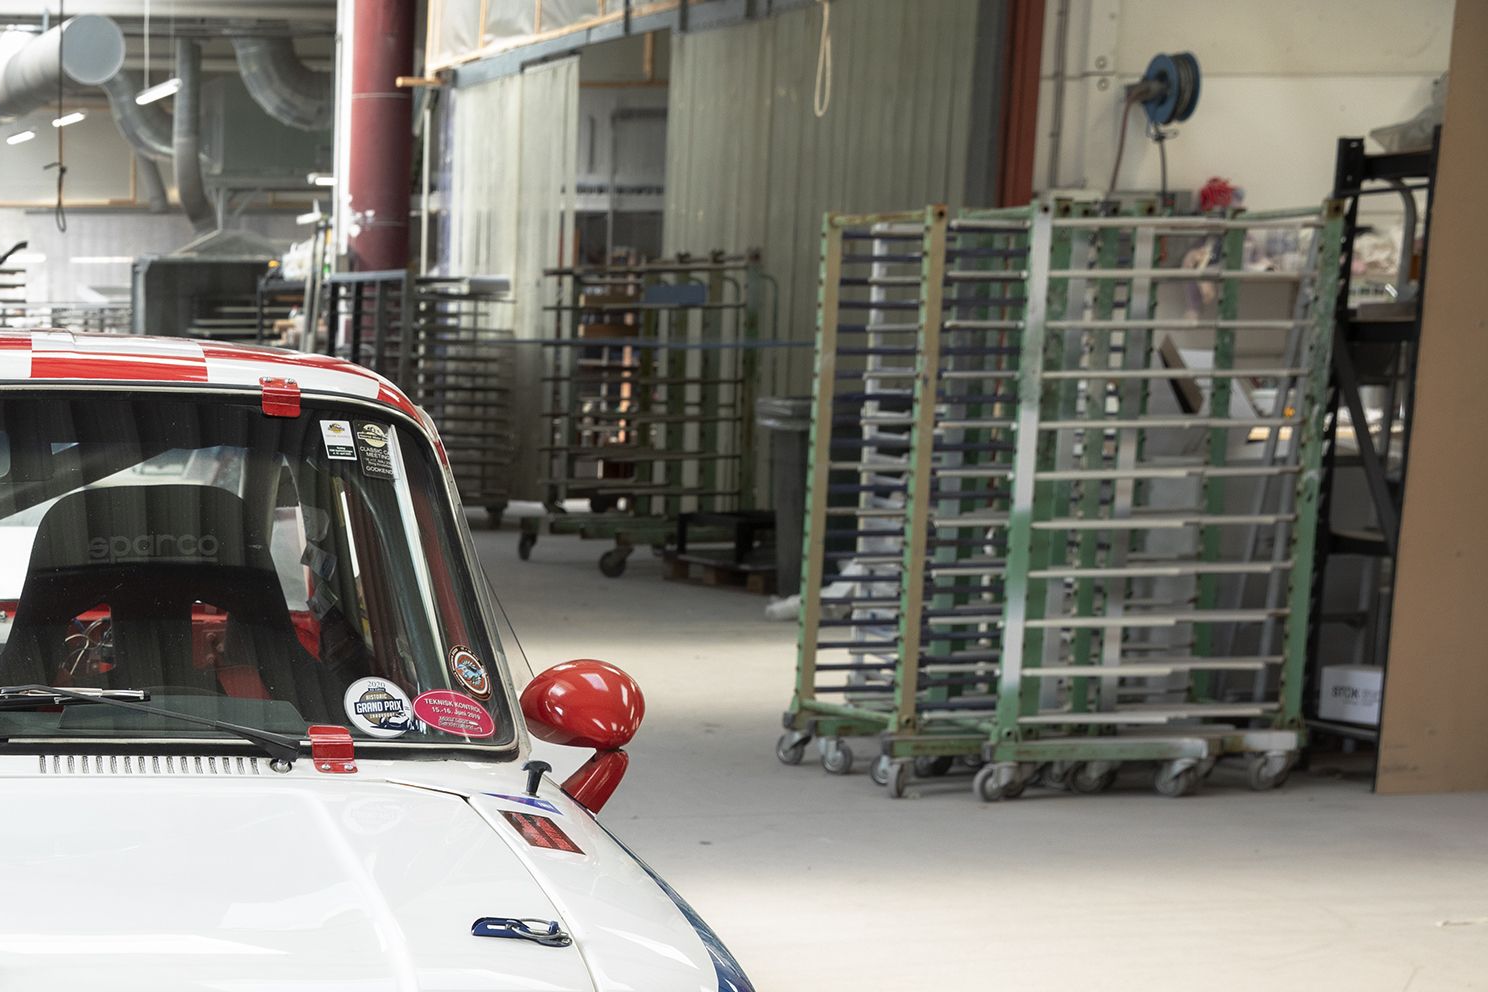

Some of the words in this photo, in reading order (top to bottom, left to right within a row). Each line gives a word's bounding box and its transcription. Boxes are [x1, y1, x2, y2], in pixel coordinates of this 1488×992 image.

[366, 465, 393, 475] GODKEND
[89, 534, 219, 564] sparco
[368, 680, 386, 688] 2020
[356, 701, 383, 714] GRAND
[384, 700, 402, 711] PRIX
[424, 698, 454, 707] TEKNISK
